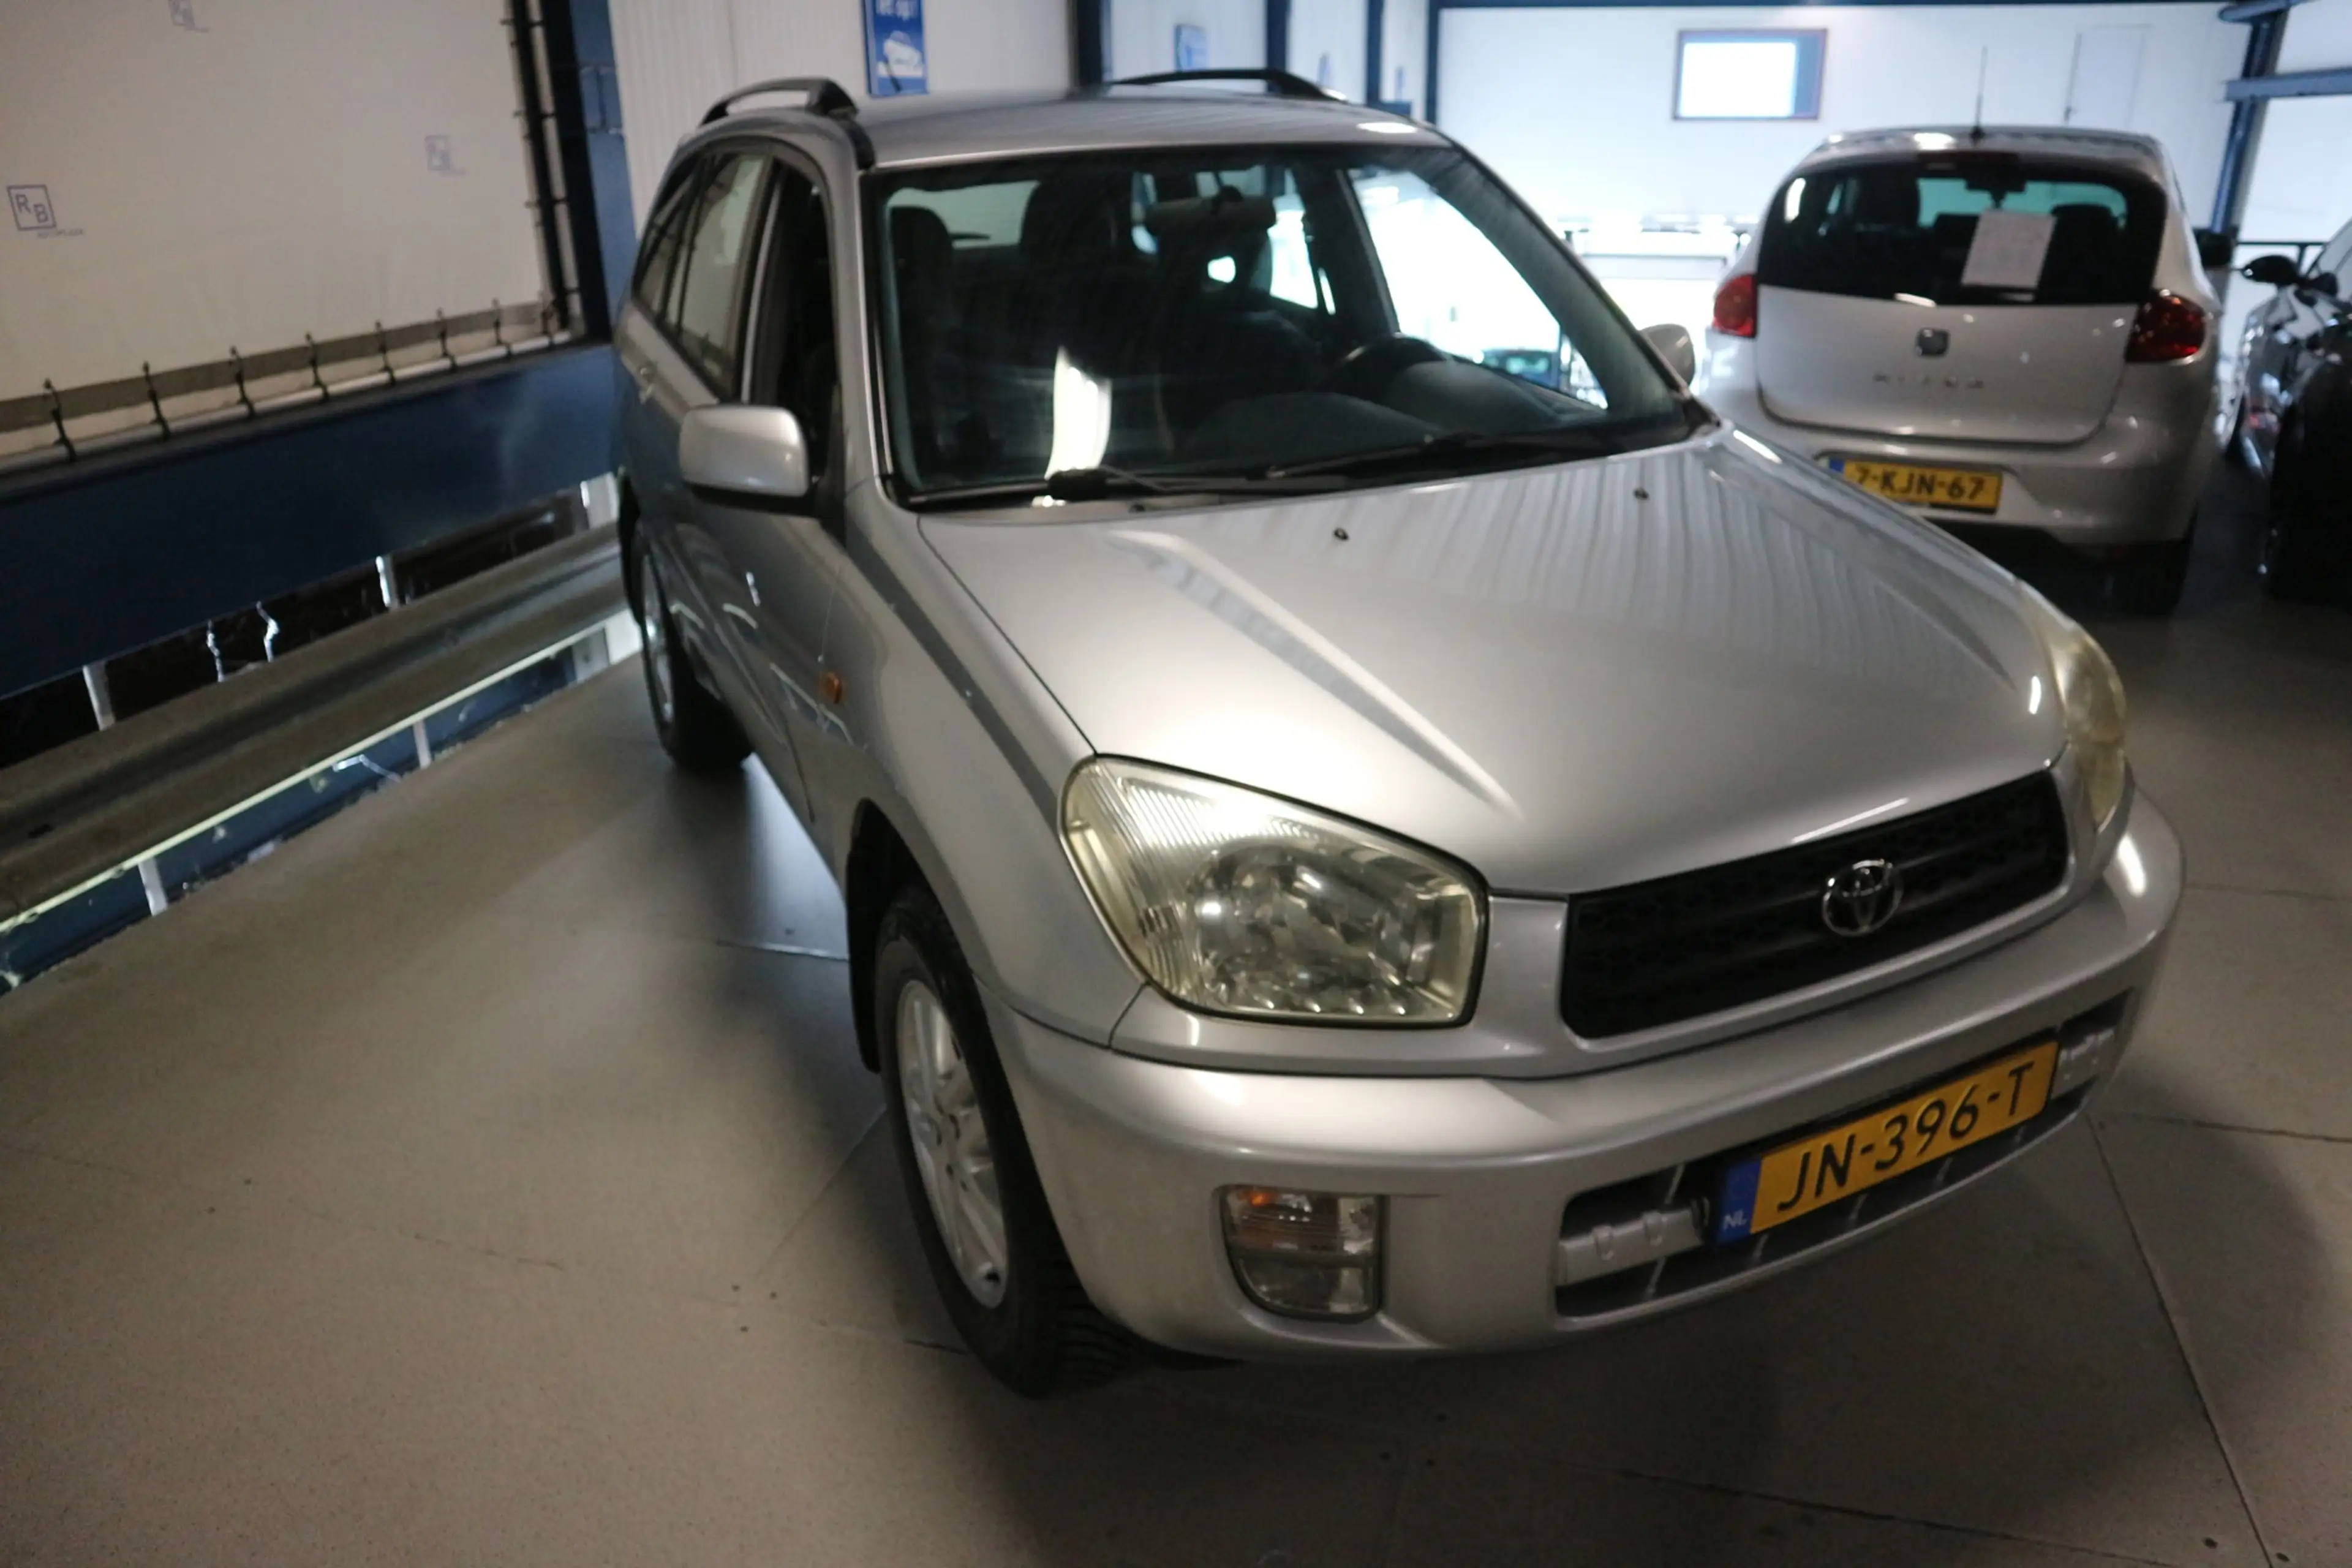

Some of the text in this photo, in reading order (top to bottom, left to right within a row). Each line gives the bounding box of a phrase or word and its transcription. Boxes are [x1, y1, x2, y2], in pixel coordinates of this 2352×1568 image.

[1855, 464, 1985, 501] 7-KJN-67
[1777, 1061, 2034, 1212] JN-396-T
[1722, 1210, 1747, 1231] NL
